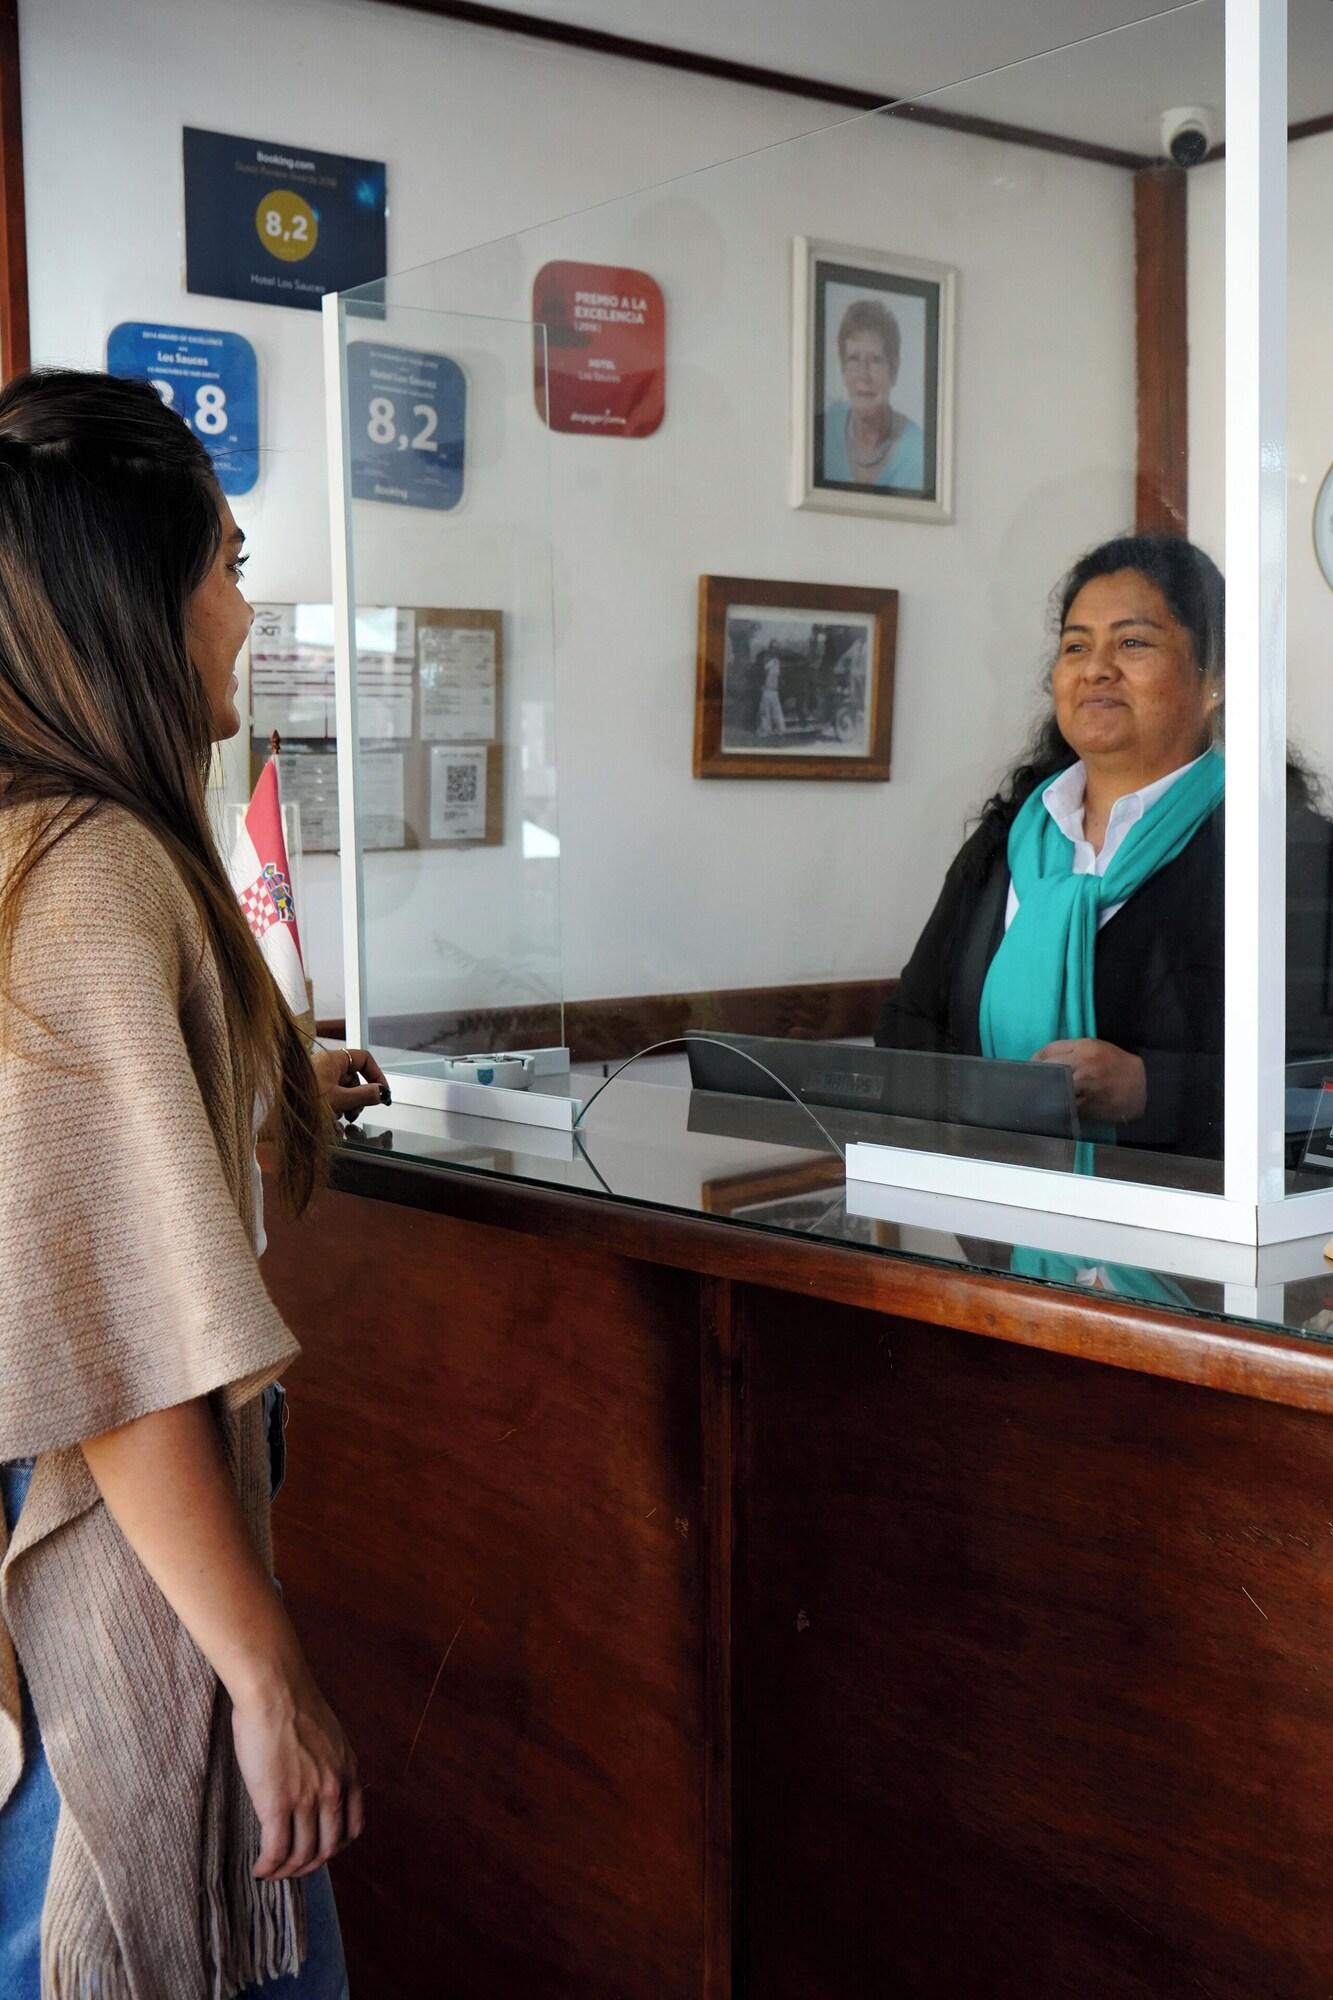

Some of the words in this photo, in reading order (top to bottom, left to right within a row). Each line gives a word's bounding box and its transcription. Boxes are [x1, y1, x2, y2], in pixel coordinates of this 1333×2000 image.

[256, 151, 315, 172] Booking.com
[265, 210, 308, 242] 8,2
[250, 273, 275, 286] Hotel
[277, 277, 293, 289] Los
[575, 292, 618, 307] PREMIO
[621, 296, 629, 309] A
[632, 298, 647, 311] LA
[575, 306, 645, 324] EXCELENCIA
[157, 351, 174, 363] Los
[175, 352, 208, 366] Sauces
[367, 397, 438, 452] 8,2
